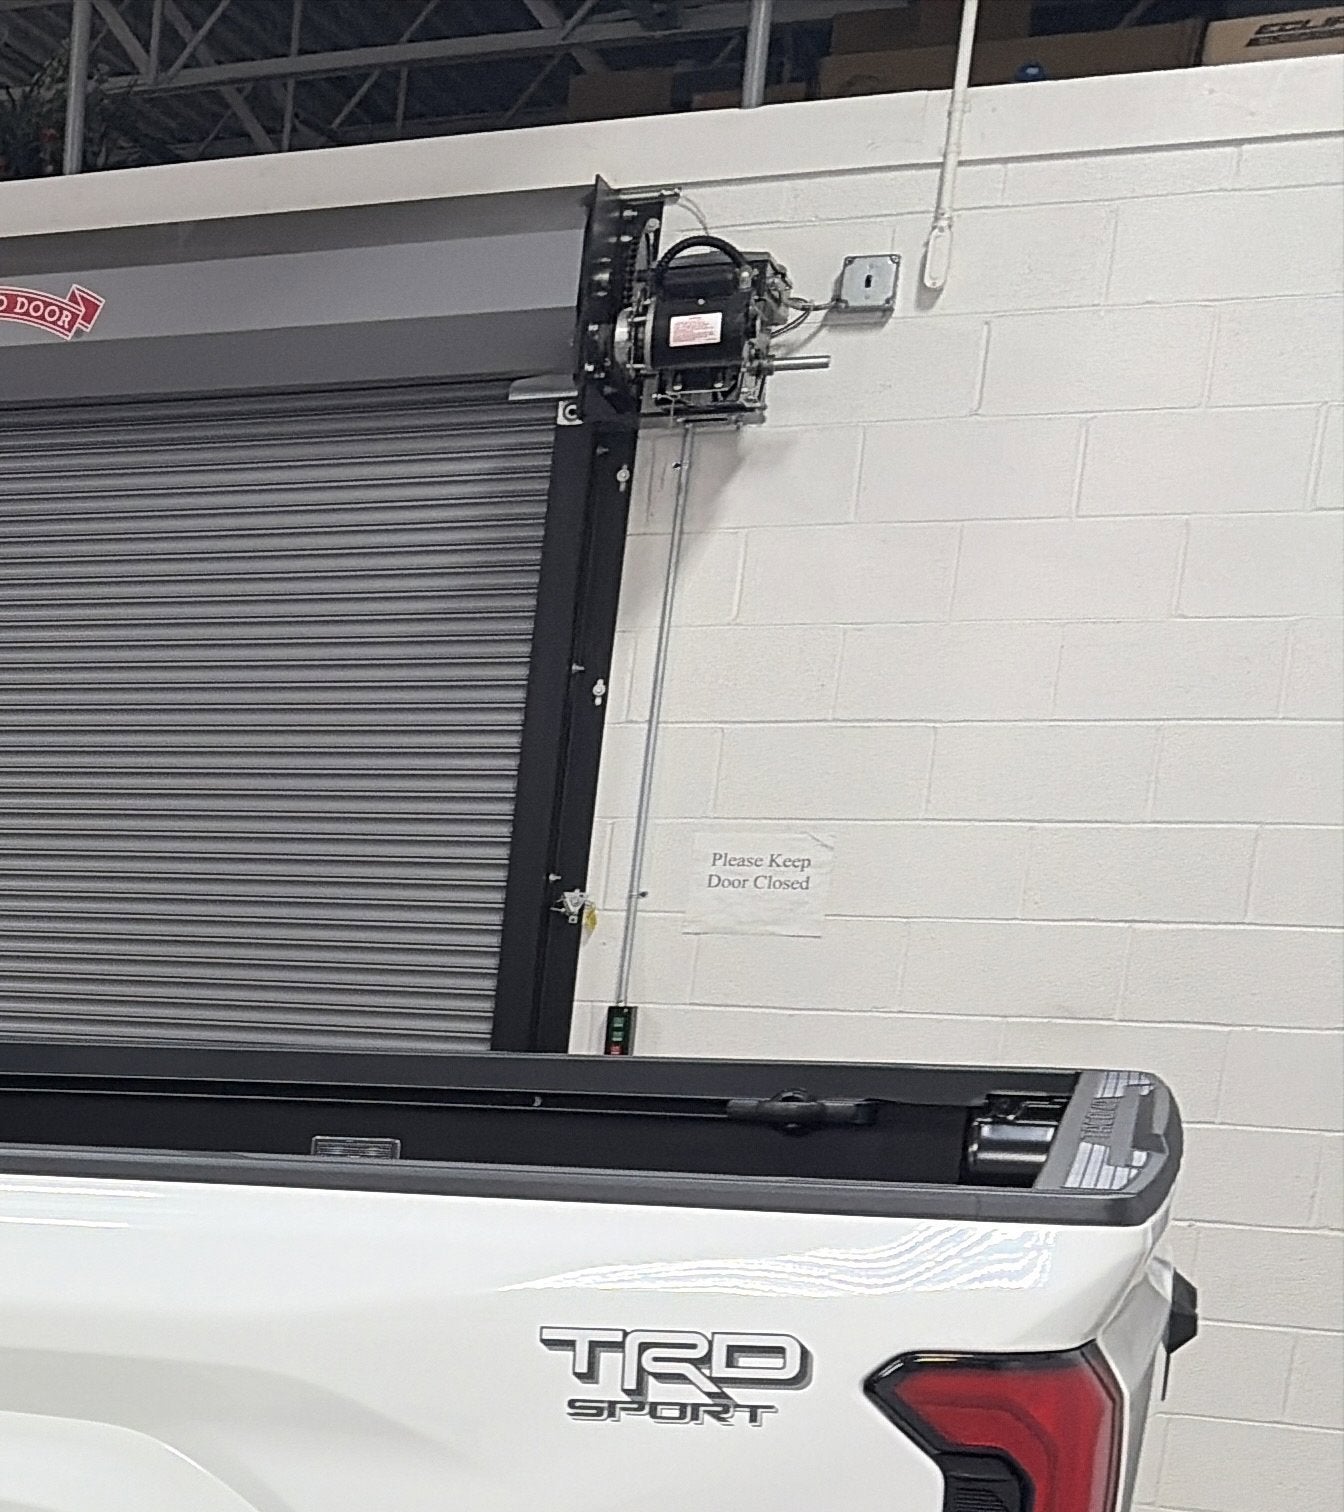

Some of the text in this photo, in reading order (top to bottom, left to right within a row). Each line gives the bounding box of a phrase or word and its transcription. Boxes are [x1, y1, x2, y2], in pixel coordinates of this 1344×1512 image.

[16, 296, 71, 330] DOOR
[711, 852, 812, 872] Please Keep
[707, 873, 811, 890] Door Closed
[539, 1325, 814, 1403] TRD
[566, 1398, 779, 1427] SPORT
